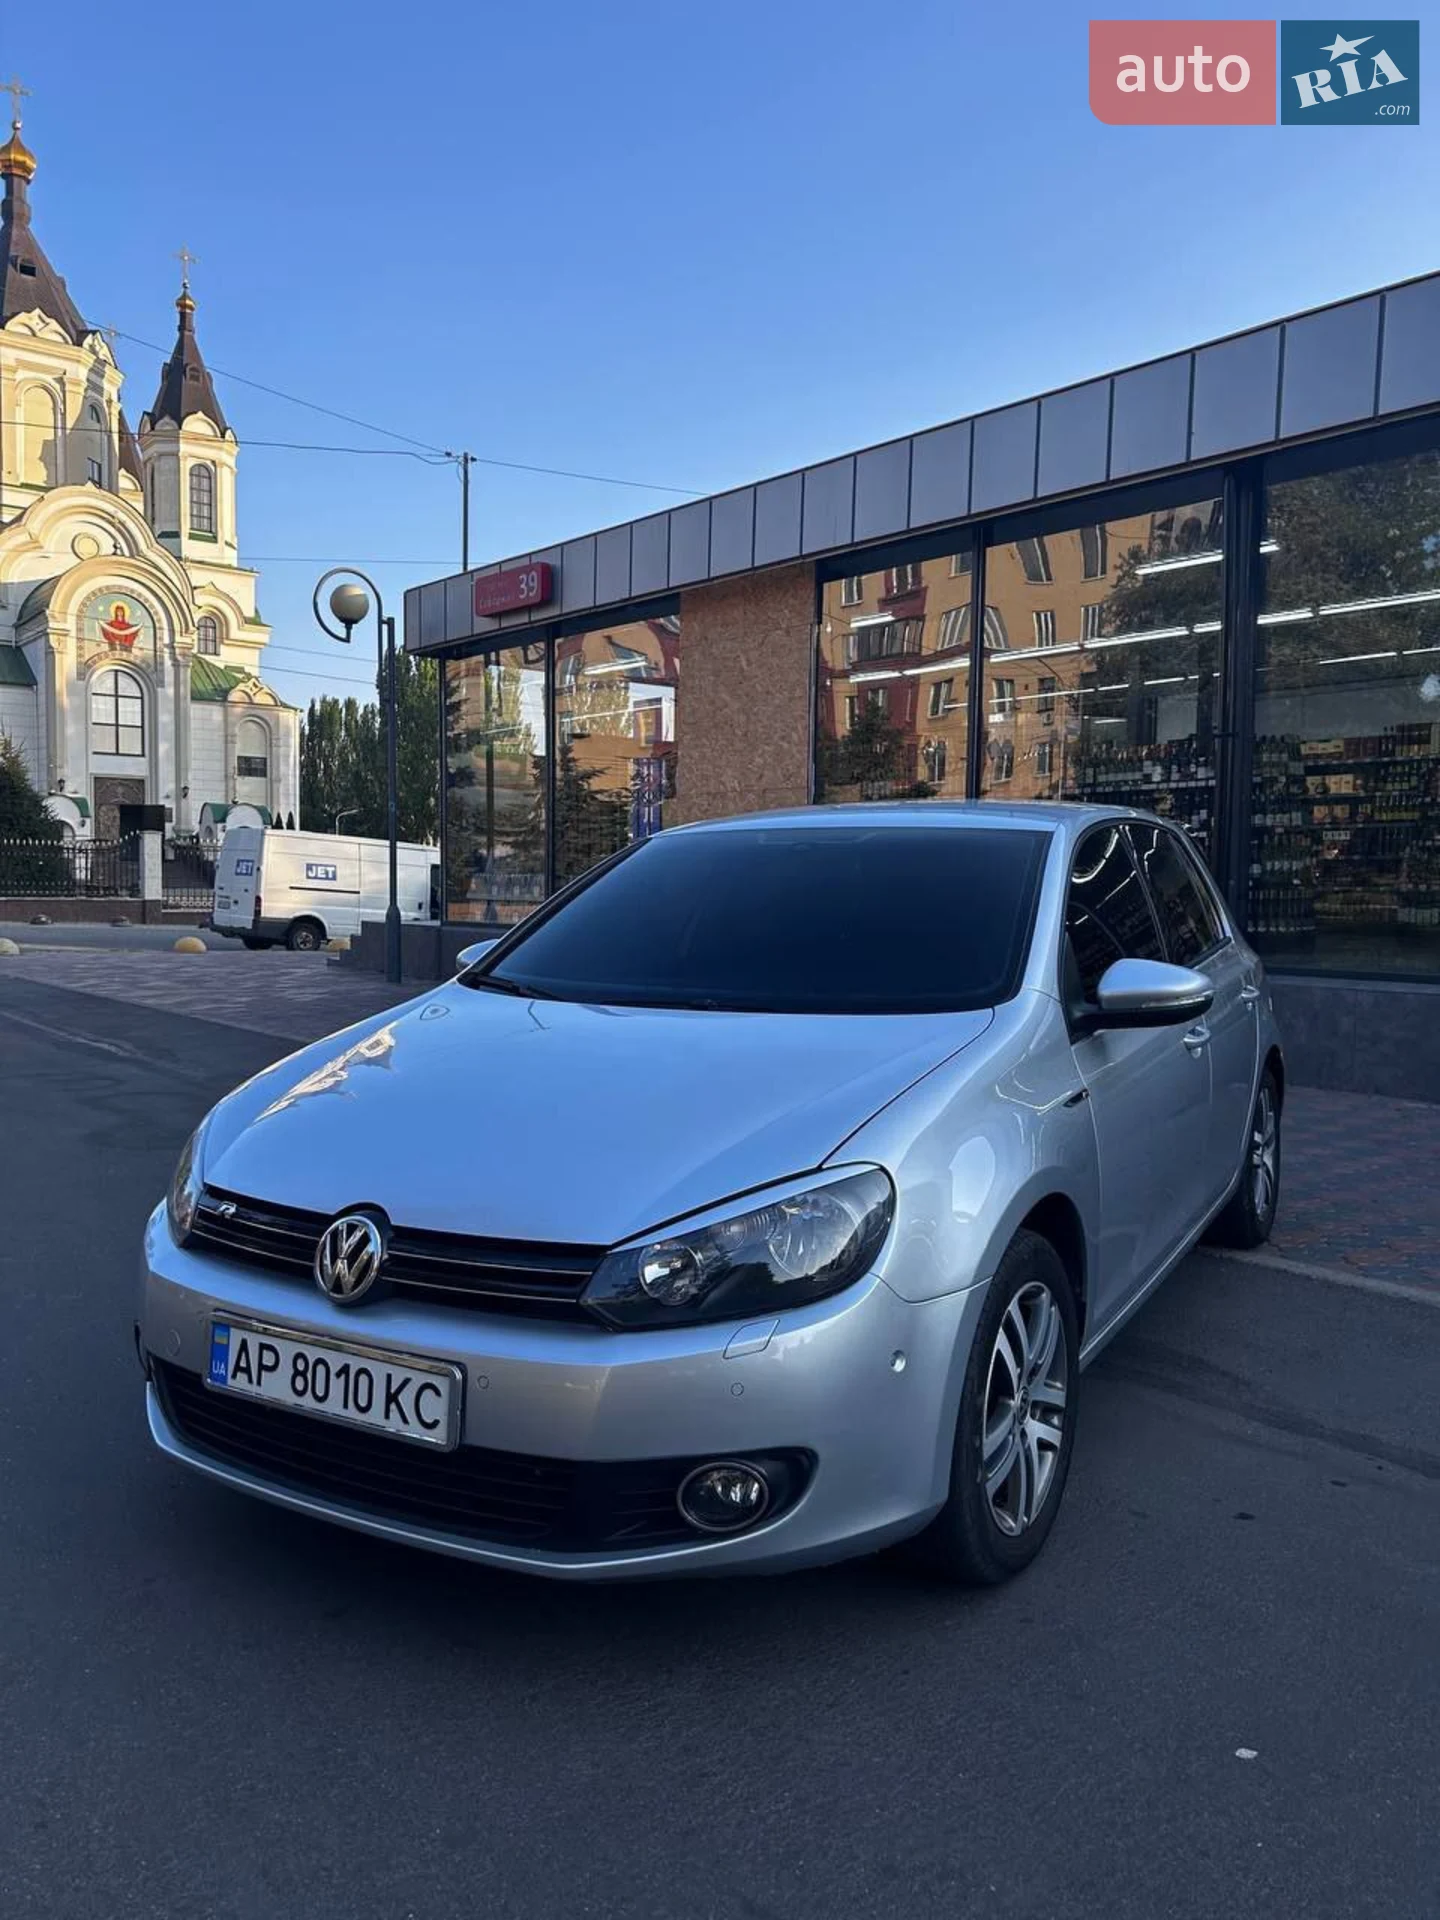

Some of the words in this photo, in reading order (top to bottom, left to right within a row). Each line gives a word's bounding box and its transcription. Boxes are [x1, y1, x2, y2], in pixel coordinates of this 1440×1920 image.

[519, 570, 538, 599] 39
[237, 860, 253, 875] JET
[308, 865, 336, 879] JET
[212, 1360, 226, 1376] UA
[231, 1337, 280, 1387] AP
[291, 1352, 374, 1414] 8010
[384, 1373, 443, 1431] KC
